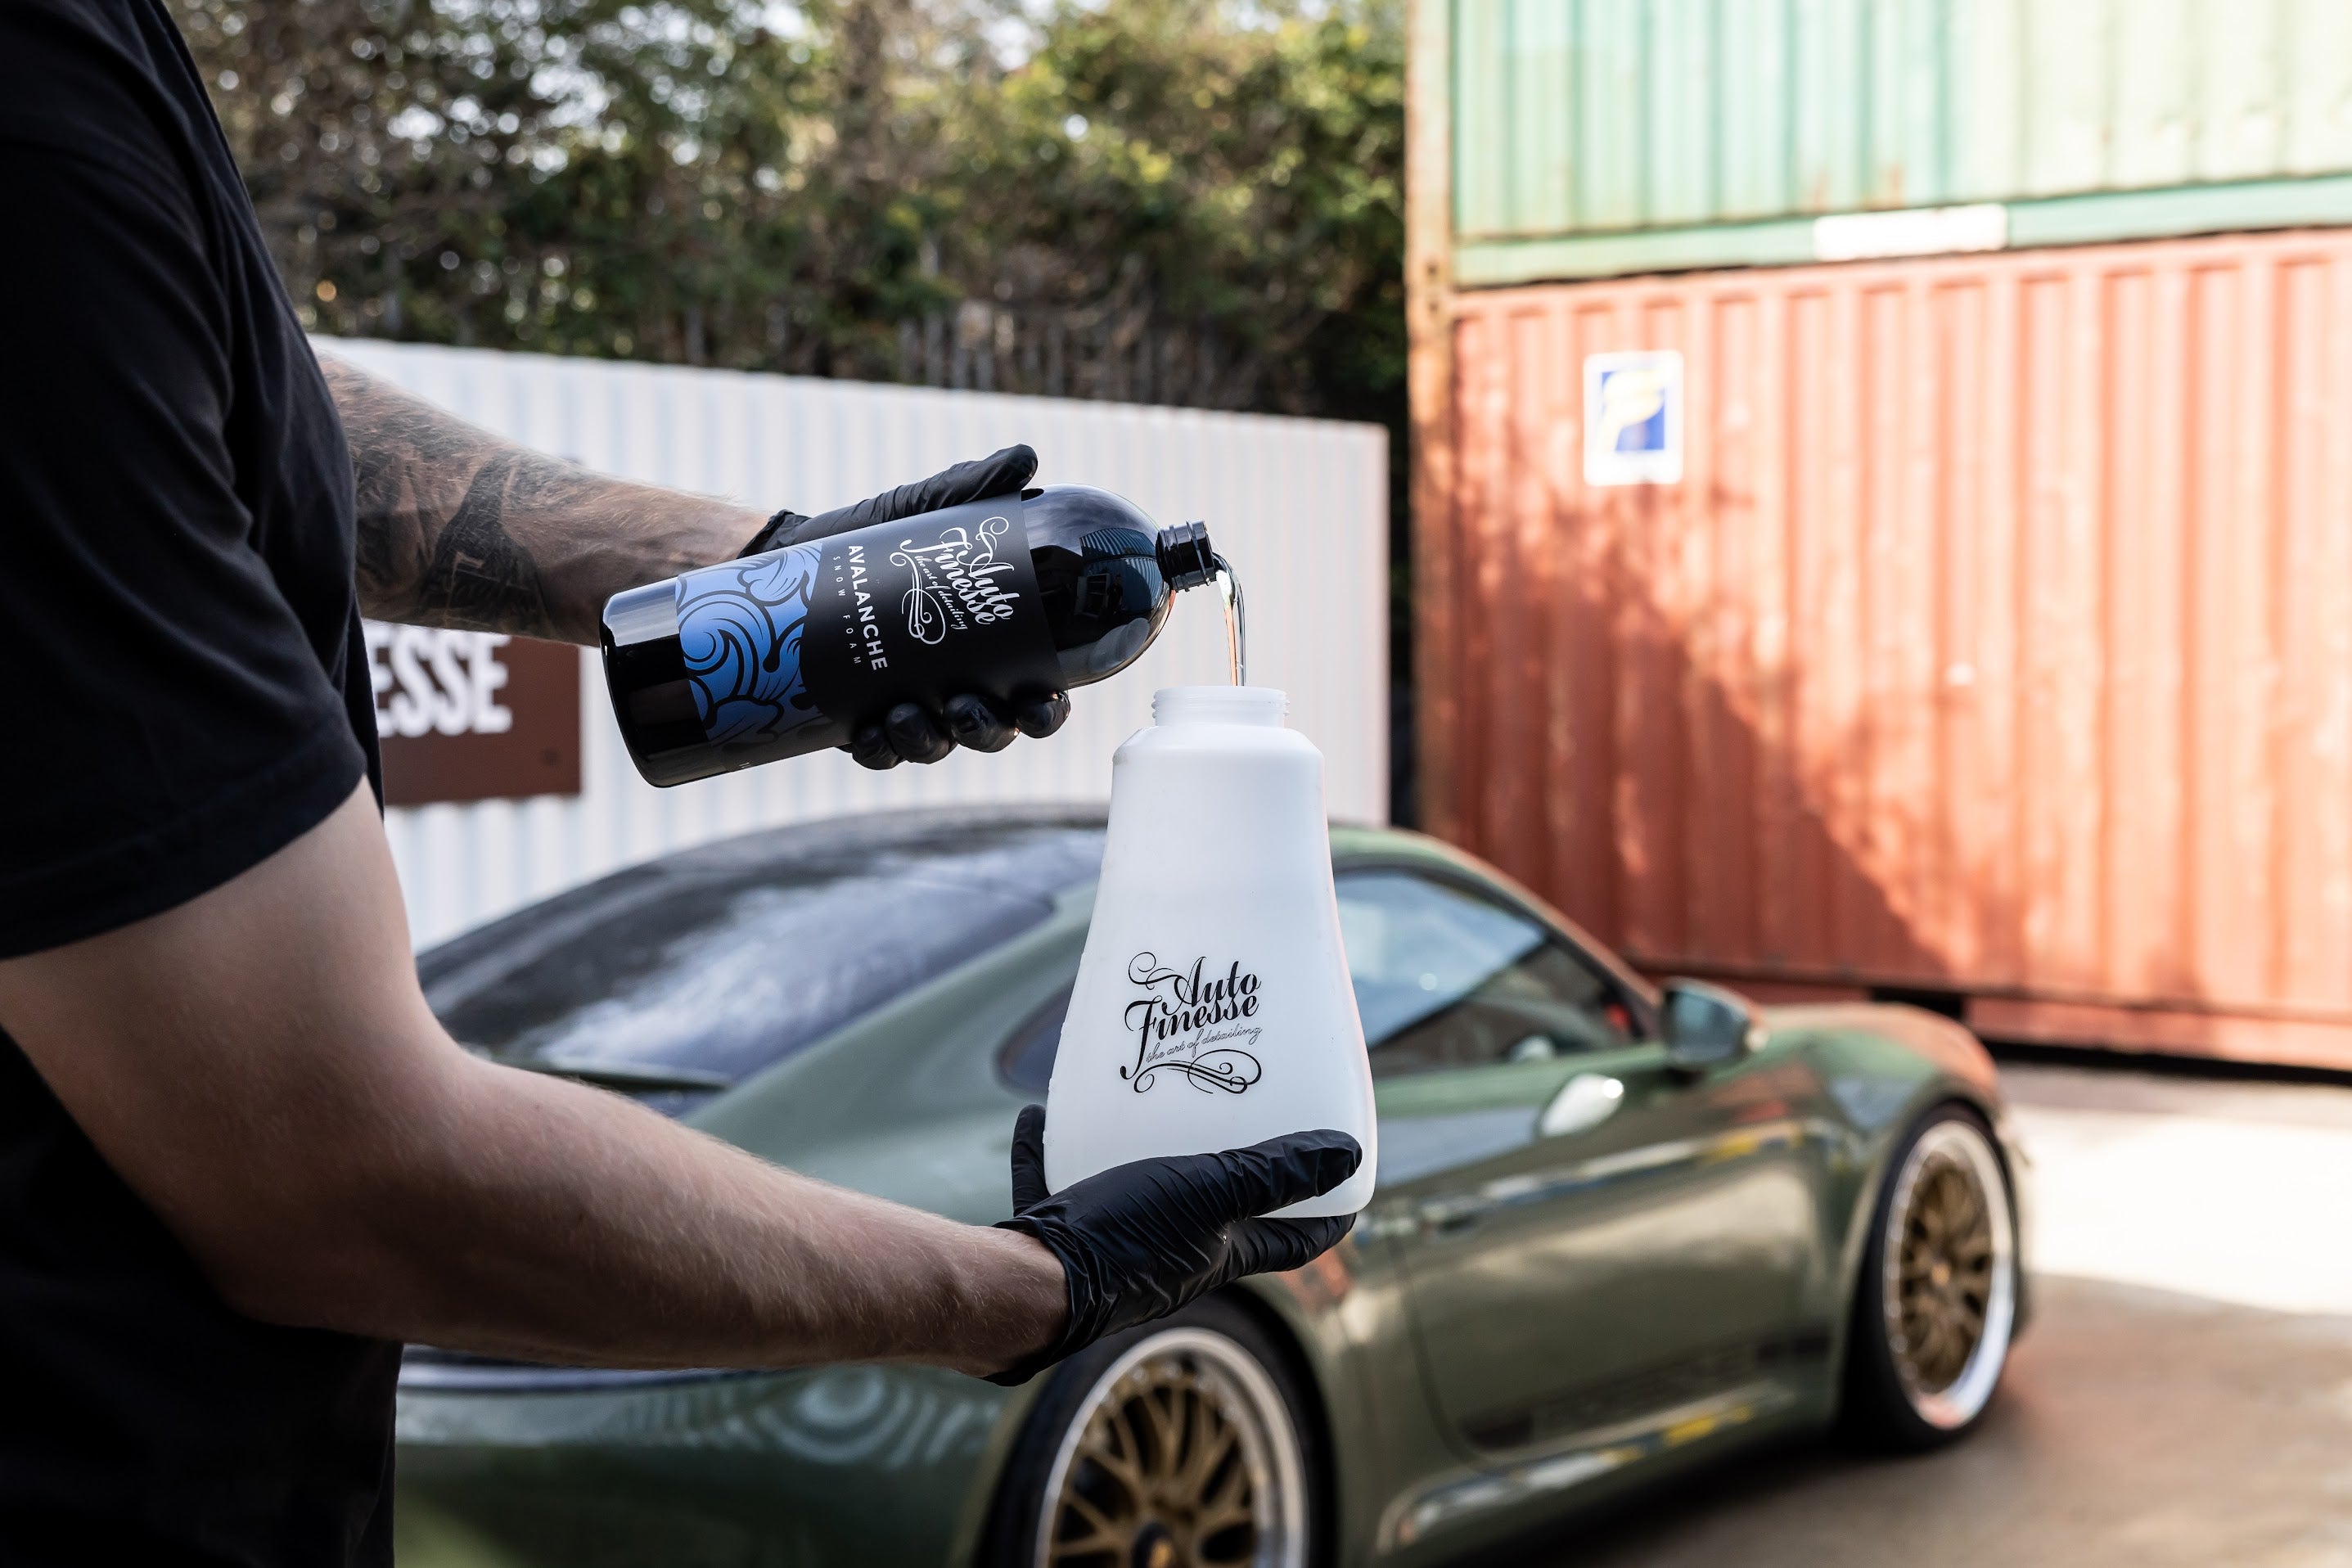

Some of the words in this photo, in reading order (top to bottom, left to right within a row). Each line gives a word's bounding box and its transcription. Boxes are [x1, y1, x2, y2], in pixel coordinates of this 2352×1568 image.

[900, 527, 995, 624] Finesse
[914, 555, 931, 568] the
[923, 568, 938, 580] art
[926, 580, 951, 590] of
[957, 516, 1020, 620] Auto
[833, 556, 846, 596] SNOW
[843, 615, 861, 664] FOAM
[848, 546, 888, 670] AVALANCHE
[938, 590, 968, 629] detailing
[1129, 952, 1261, 1016] Auto
[1120, 995, 1259, 1079] Finesse
[1147, 1043, 1165, 1062] the
[1167, 1041, 1185, 1055] art
[1187, 1029, 1204, 1058] of
[1202, 1023, 1262, 1045] detailing
